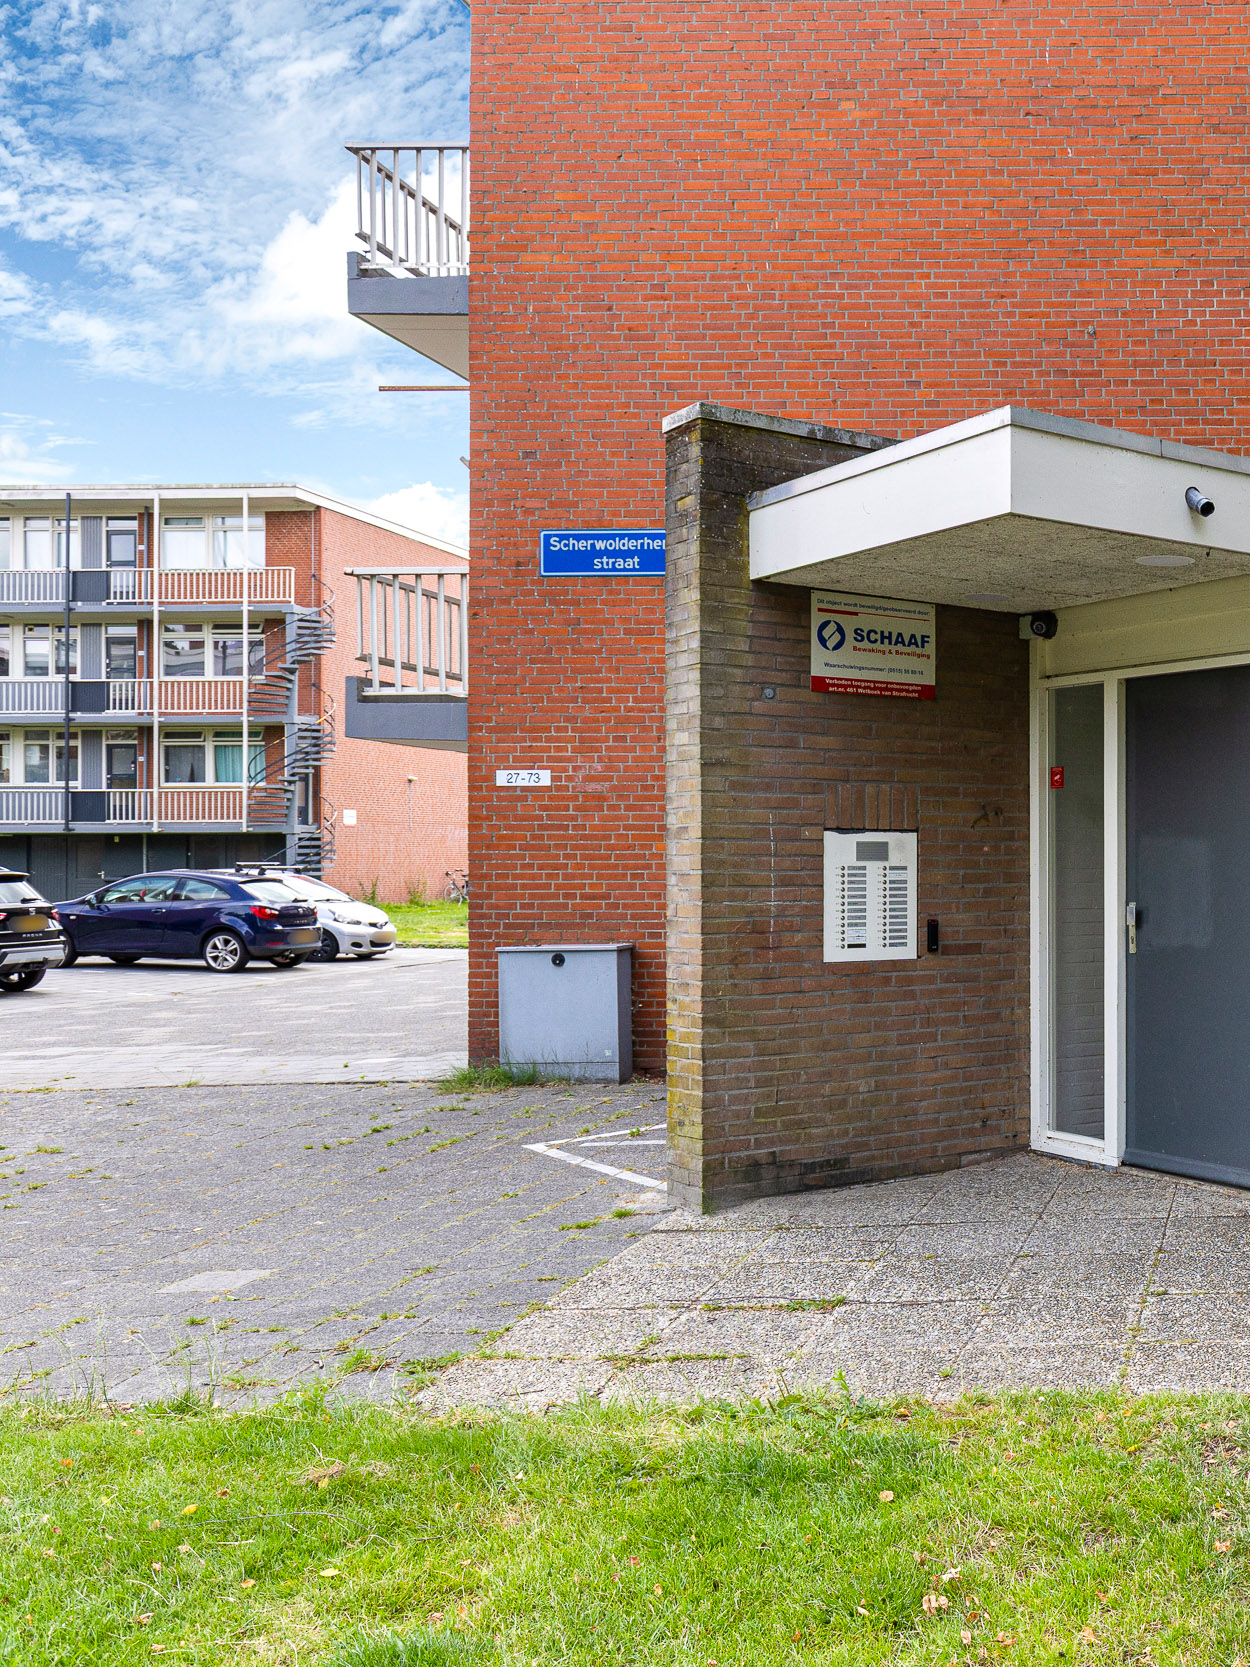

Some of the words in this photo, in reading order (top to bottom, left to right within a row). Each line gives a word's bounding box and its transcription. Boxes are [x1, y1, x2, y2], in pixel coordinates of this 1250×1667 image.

[593, 555, 640, 569] straat
[853, 627, 931, 648] SCHAAF
[852, 646, 886, 655] Bewaking
[895, 649, 931, 660] Beveiliging
[825, 678, 851, 686] Verboden
[887, 683, 921, 691] onbevoegden
[506, 772, 541, 784] 27-73
